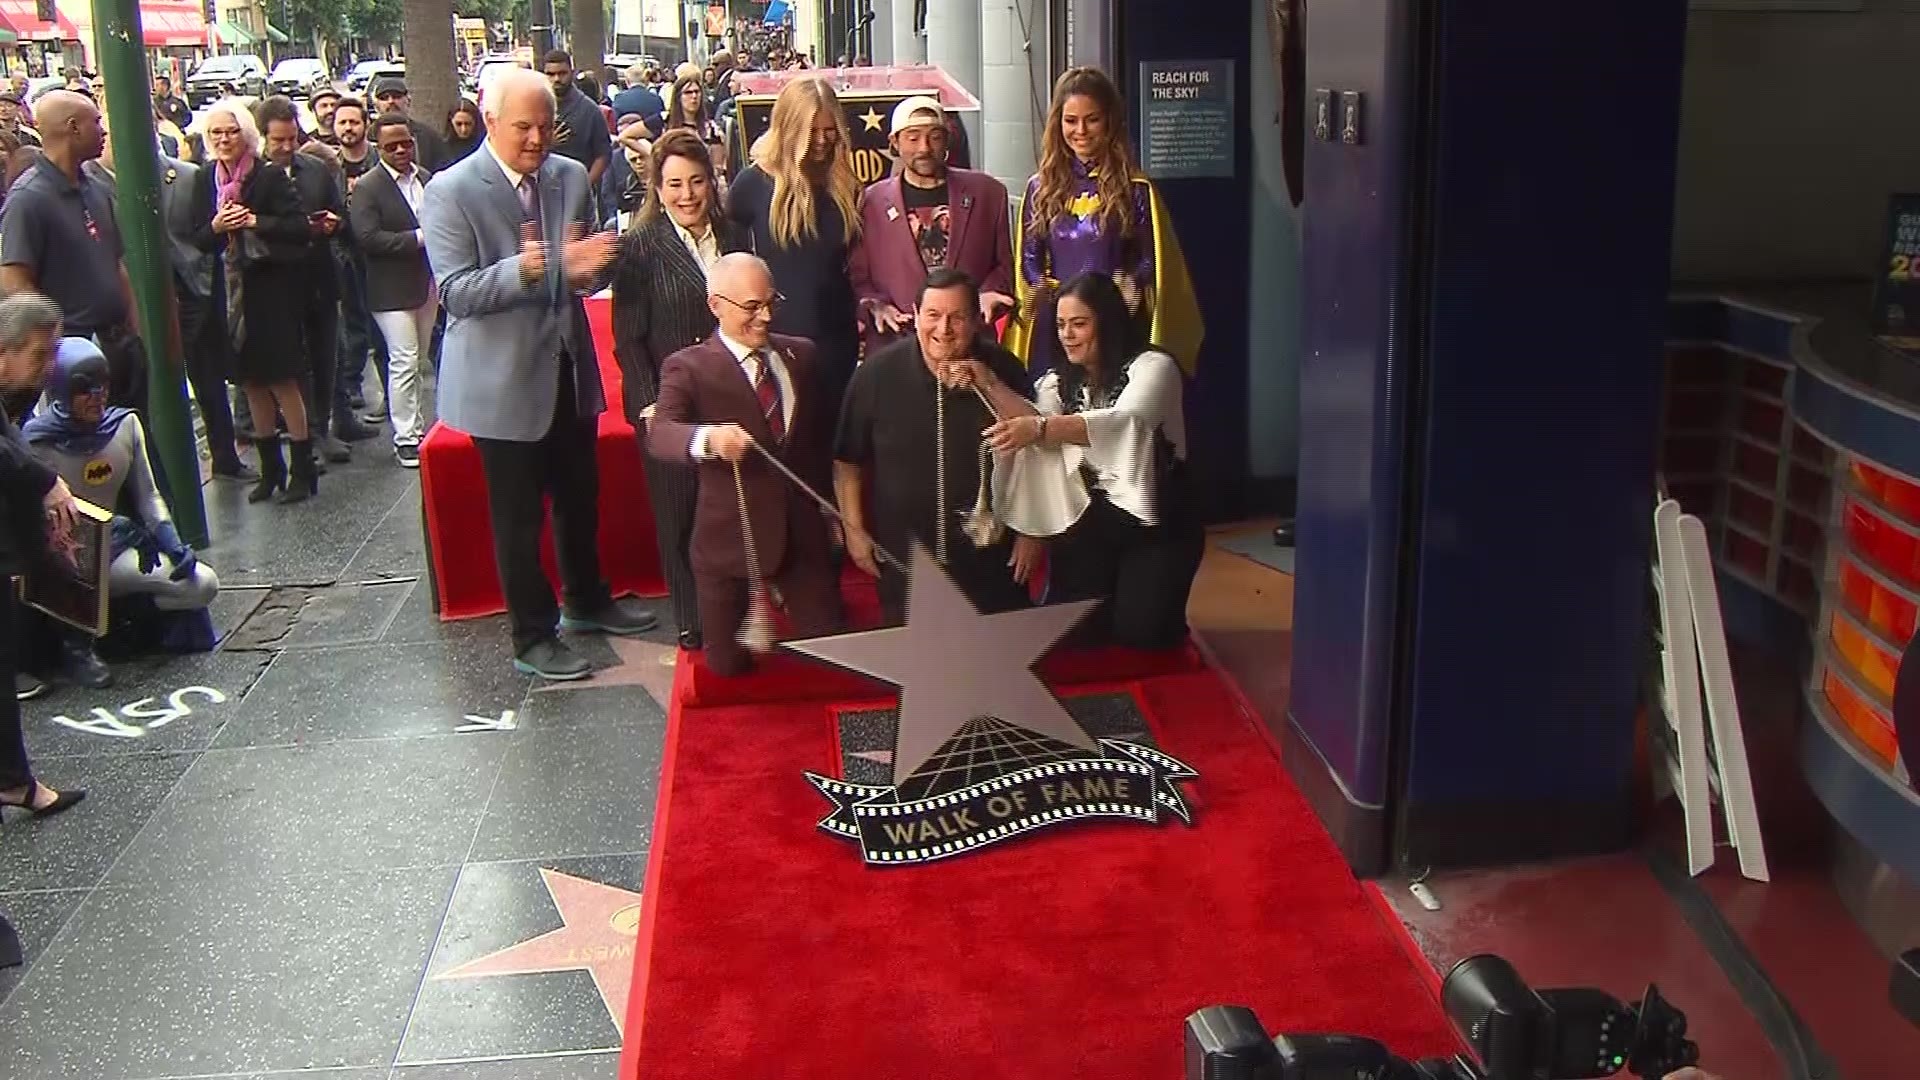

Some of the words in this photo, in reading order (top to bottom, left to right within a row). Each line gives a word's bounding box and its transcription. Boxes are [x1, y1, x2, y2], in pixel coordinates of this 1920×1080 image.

[1152, 72, 1187, 84] REACH
[1189, 71, 1209, 83] FOR
[1152, 87, 1174, 99] THE
[1175, 87, 1199, 99] SKY!
[52, 685, 226, 737] USA
[883, 807, 978, 845] WALK
[986, 790, 1028, 818] OF
[1040, 776, 1130, 804] FAME
[560, 943, 632, 964] WEST
